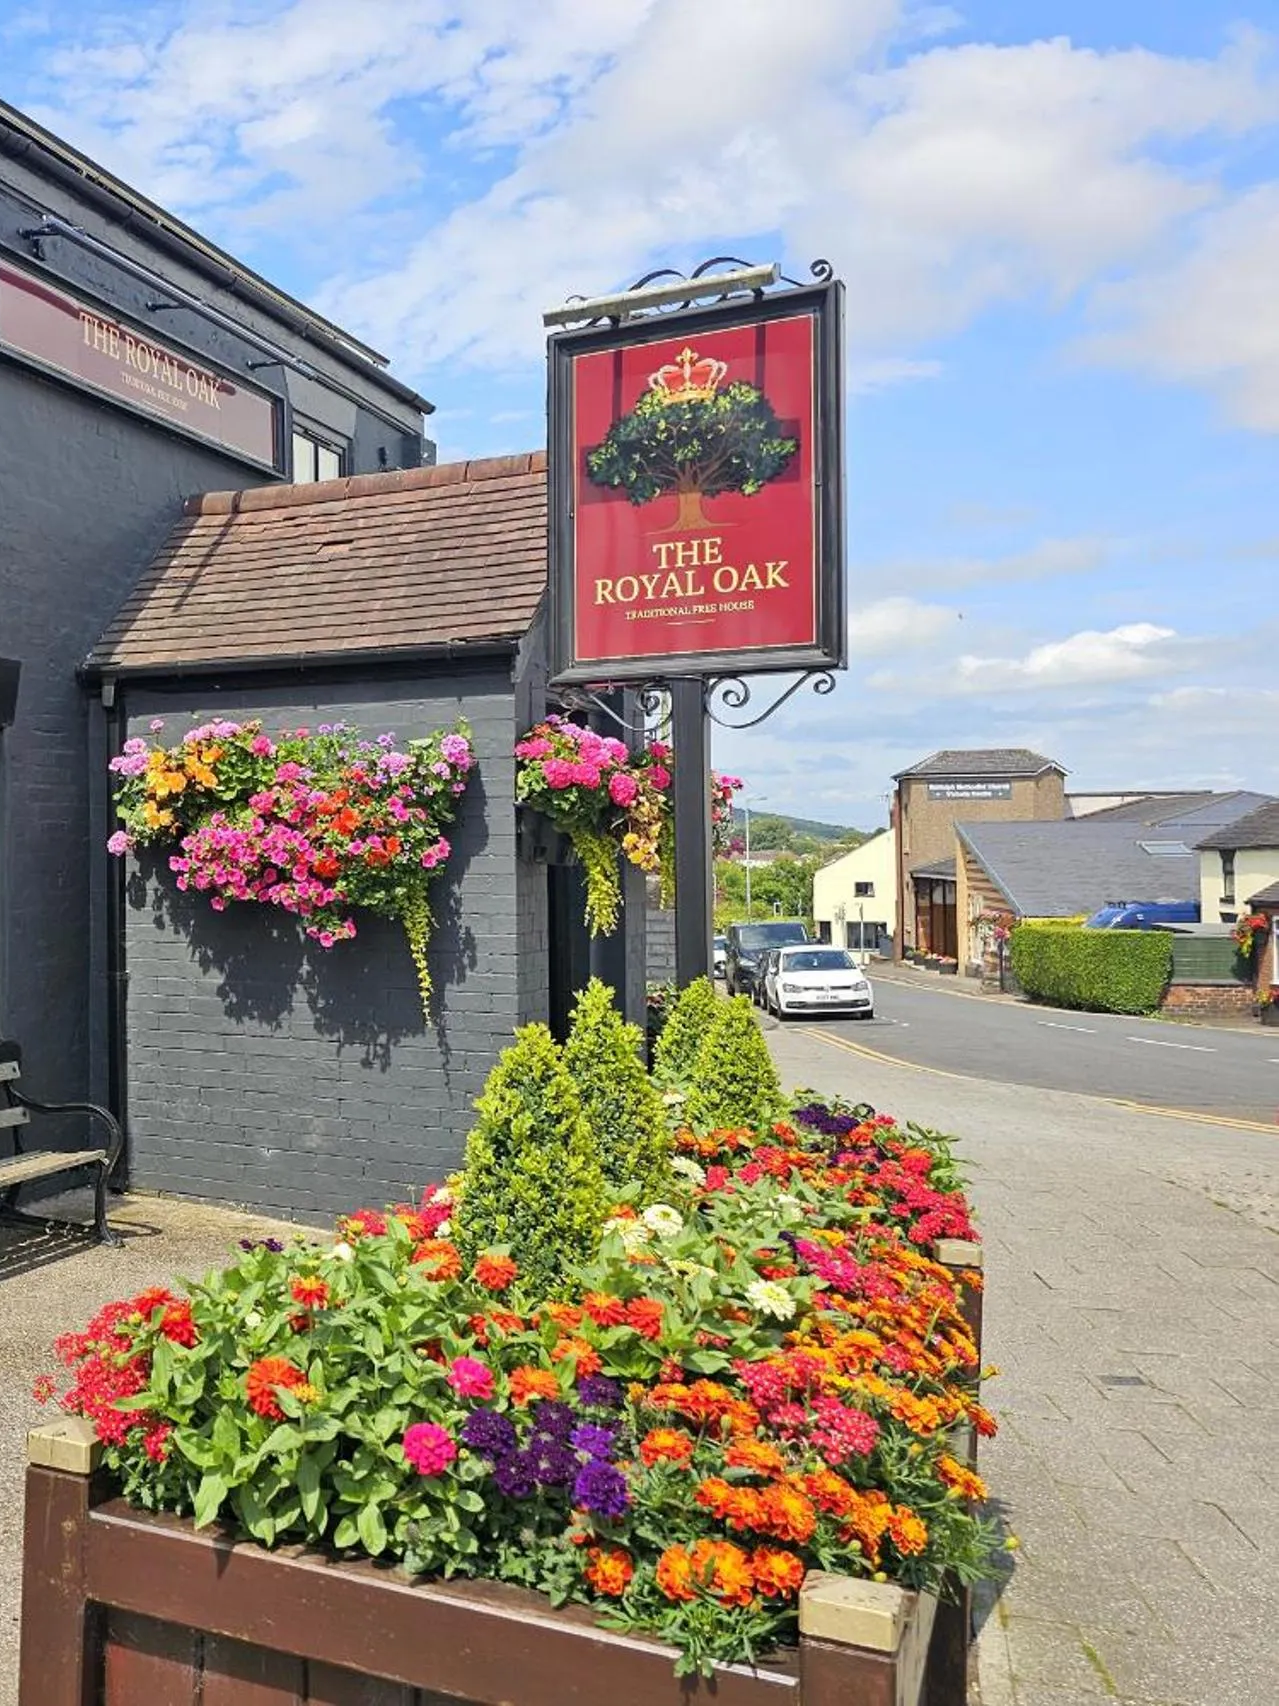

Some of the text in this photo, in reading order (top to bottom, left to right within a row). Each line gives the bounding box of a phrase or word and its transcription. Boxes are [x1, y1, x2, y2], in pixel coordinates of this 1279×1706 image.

[80, 311, 120, 360] THE
[125, 335, 183, 391] ROYAL
[186, 369, 221, 410] OAK
[652, 537, 723, 569] THE
[594, 561, 789, 605] ROYAL OAK
[625, 606, 691, 620] TRADITIONAL
[718, 600, 755, 612] HOUSE
